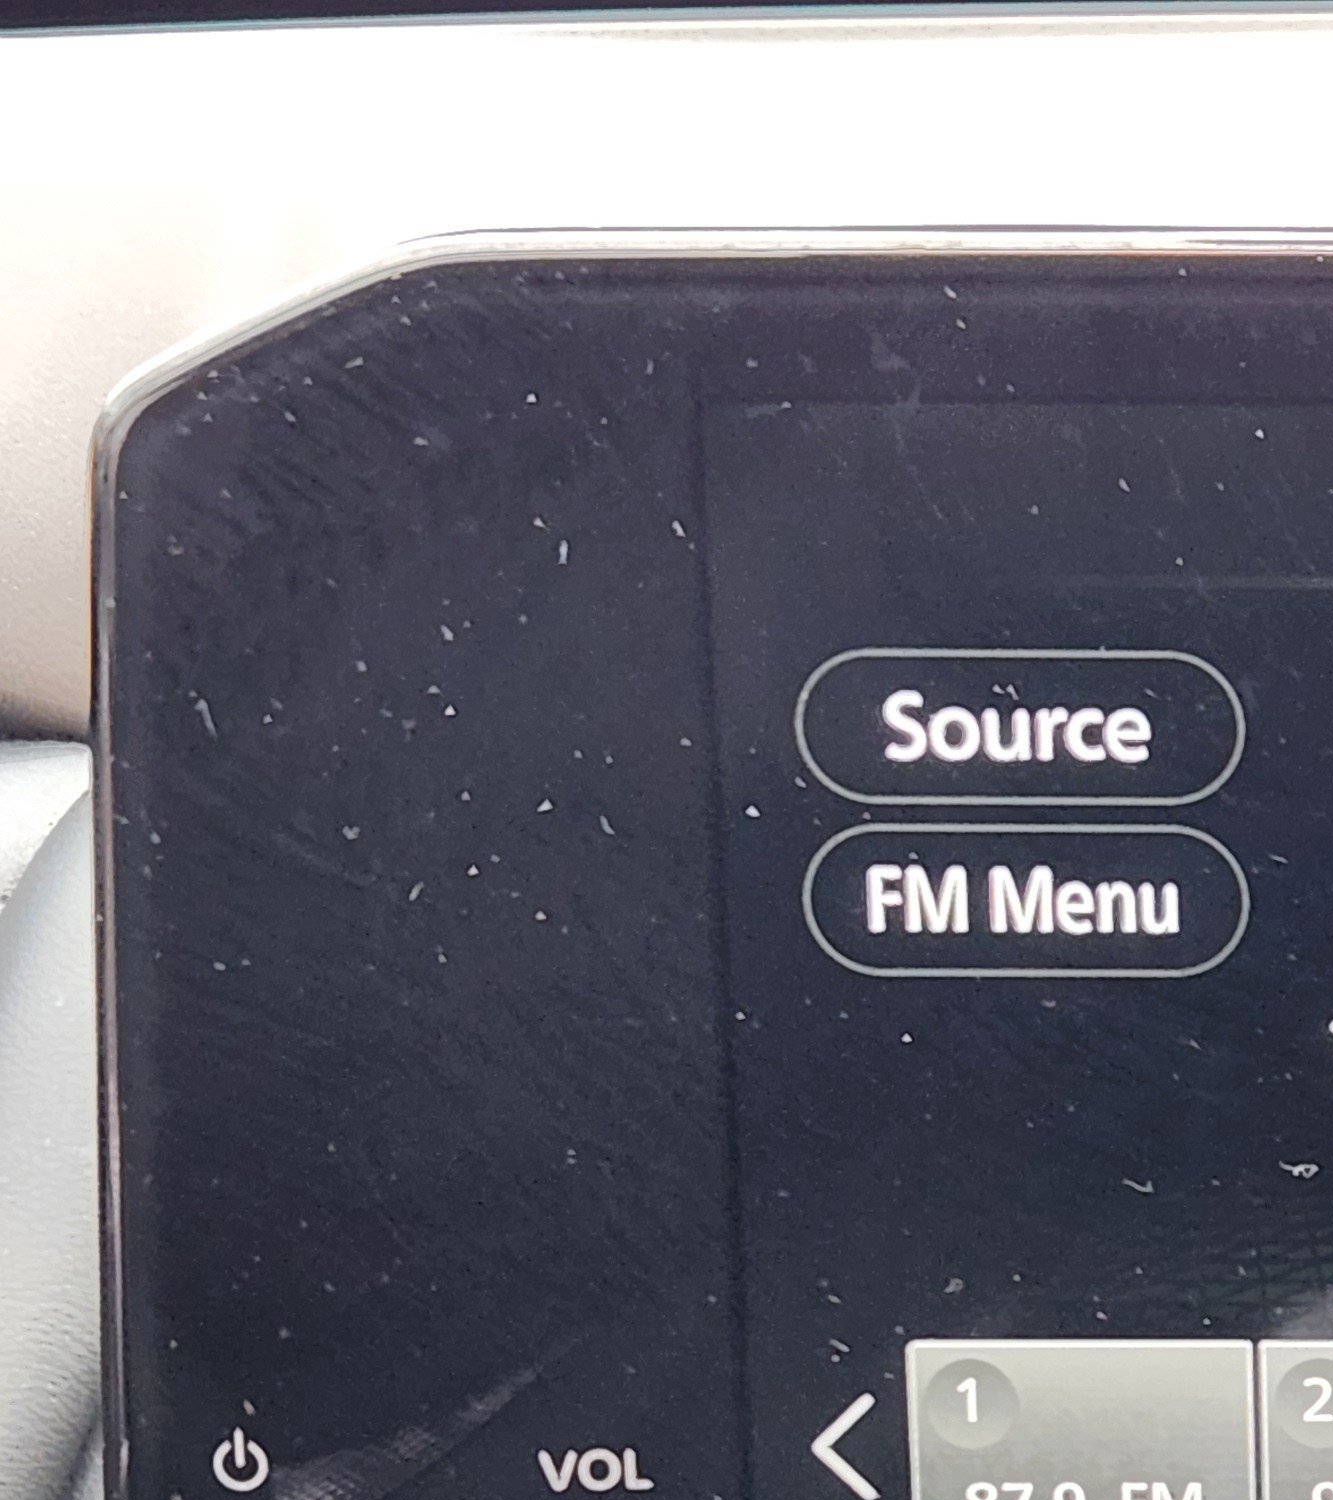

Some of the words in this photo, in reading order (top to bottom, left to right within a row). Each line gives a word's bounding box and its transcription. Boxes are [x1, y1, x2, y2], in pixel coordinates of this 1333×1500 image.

[881, 688, 1153, 765] Source
[864, 863, 971, 935] FM
[987, 864, 1181, 937] Menu
[955, 1376, 979, 1424] 1
[536, 1446, 656, 1493] VOL
